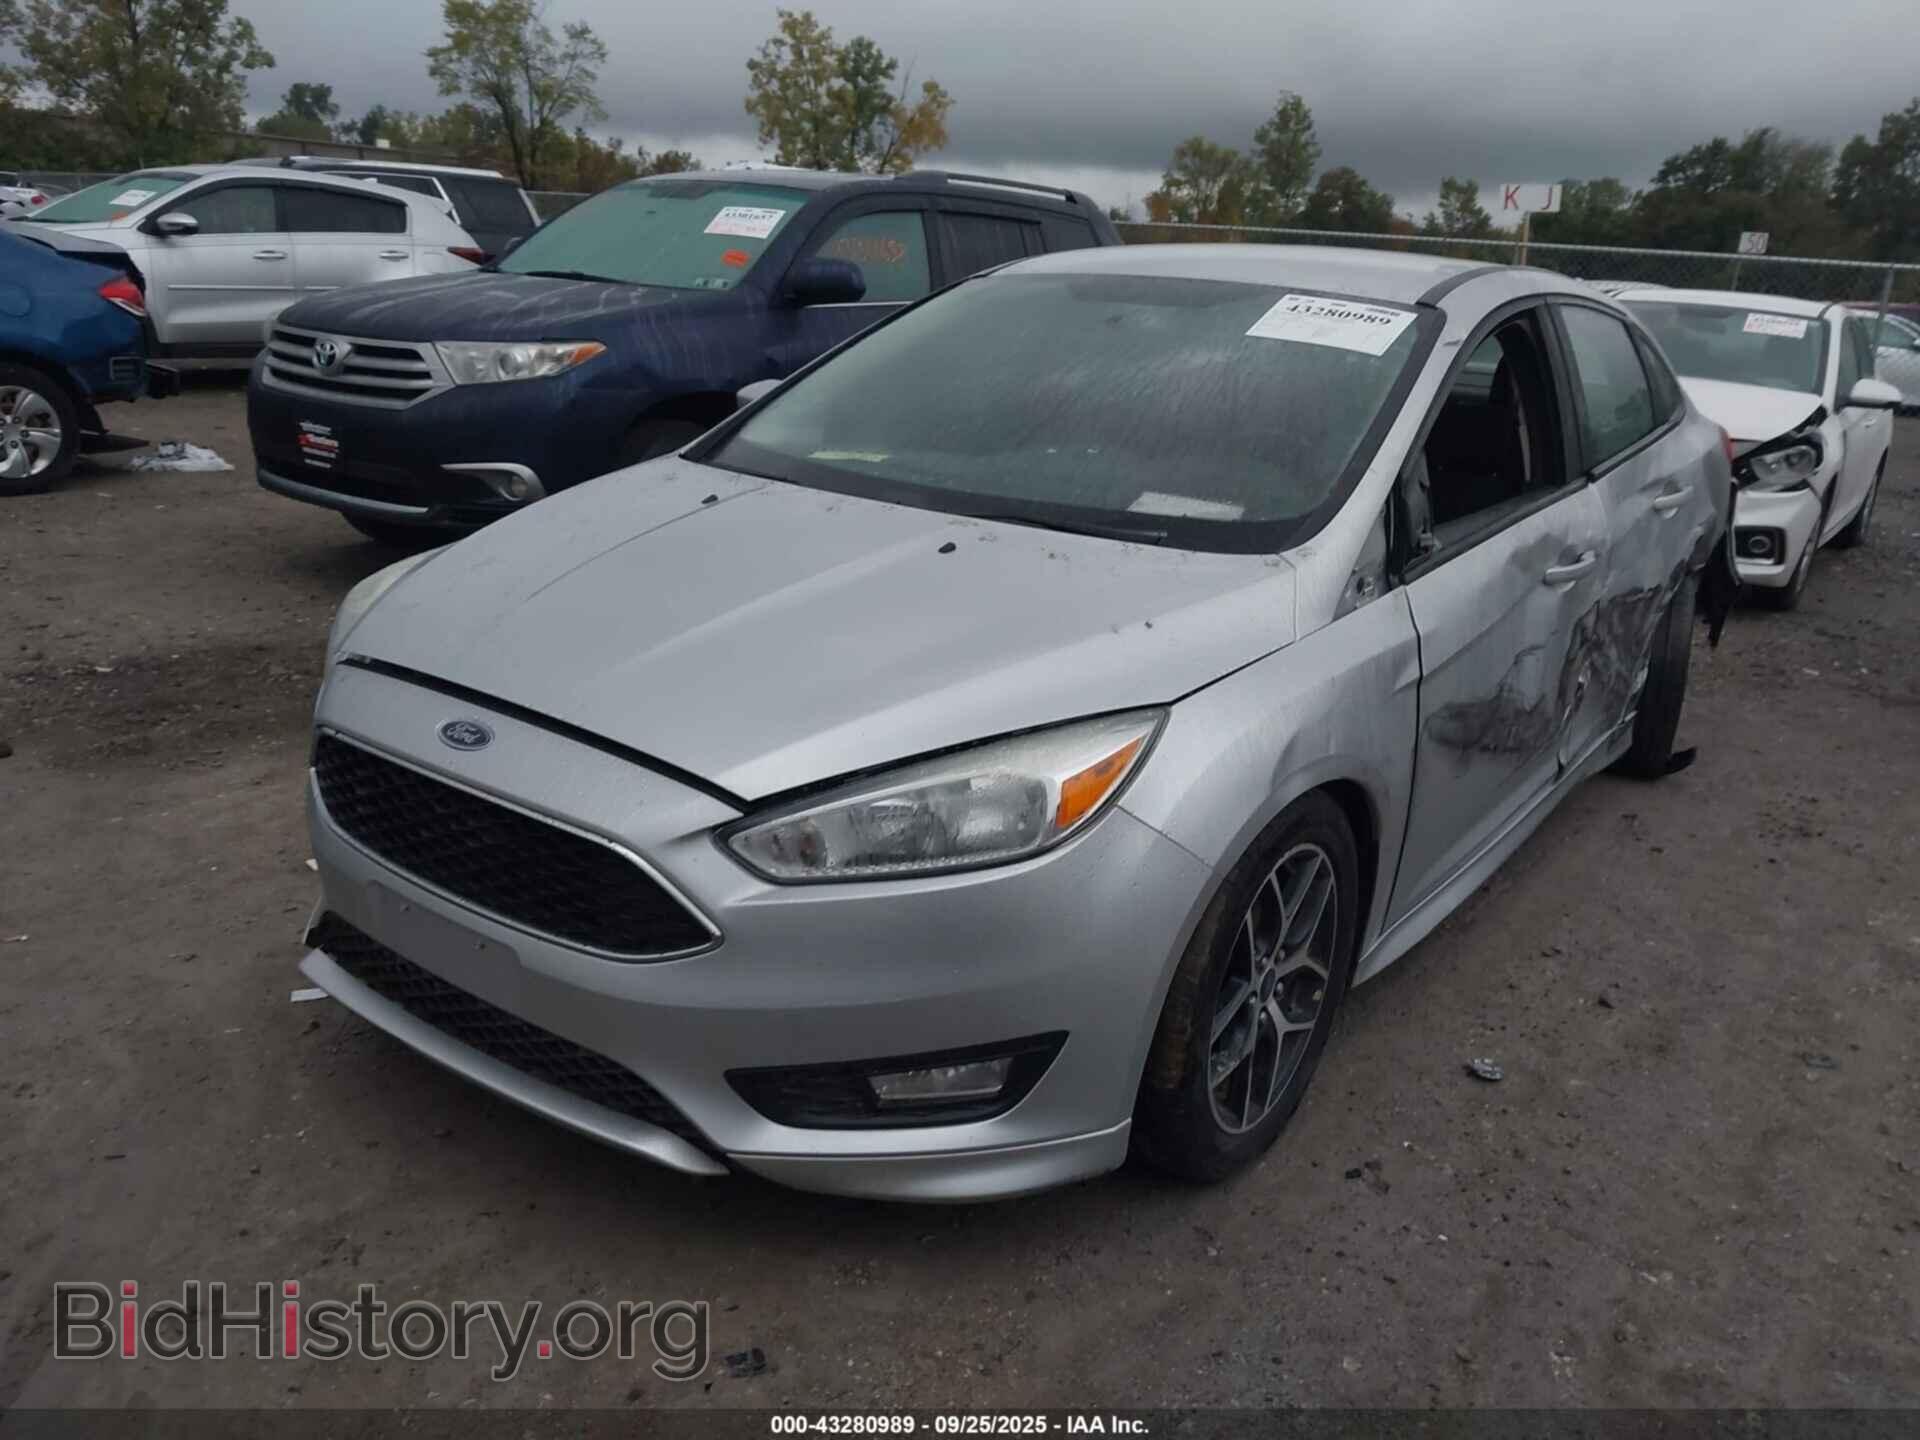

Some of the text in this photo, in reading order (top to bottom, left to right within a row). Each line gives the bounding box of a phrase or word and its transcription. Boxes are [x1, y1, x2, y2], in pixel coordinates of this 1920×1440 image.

[1504, 184, 1553, 210] K J
[1285, 303, 1392, 326] 43280989
